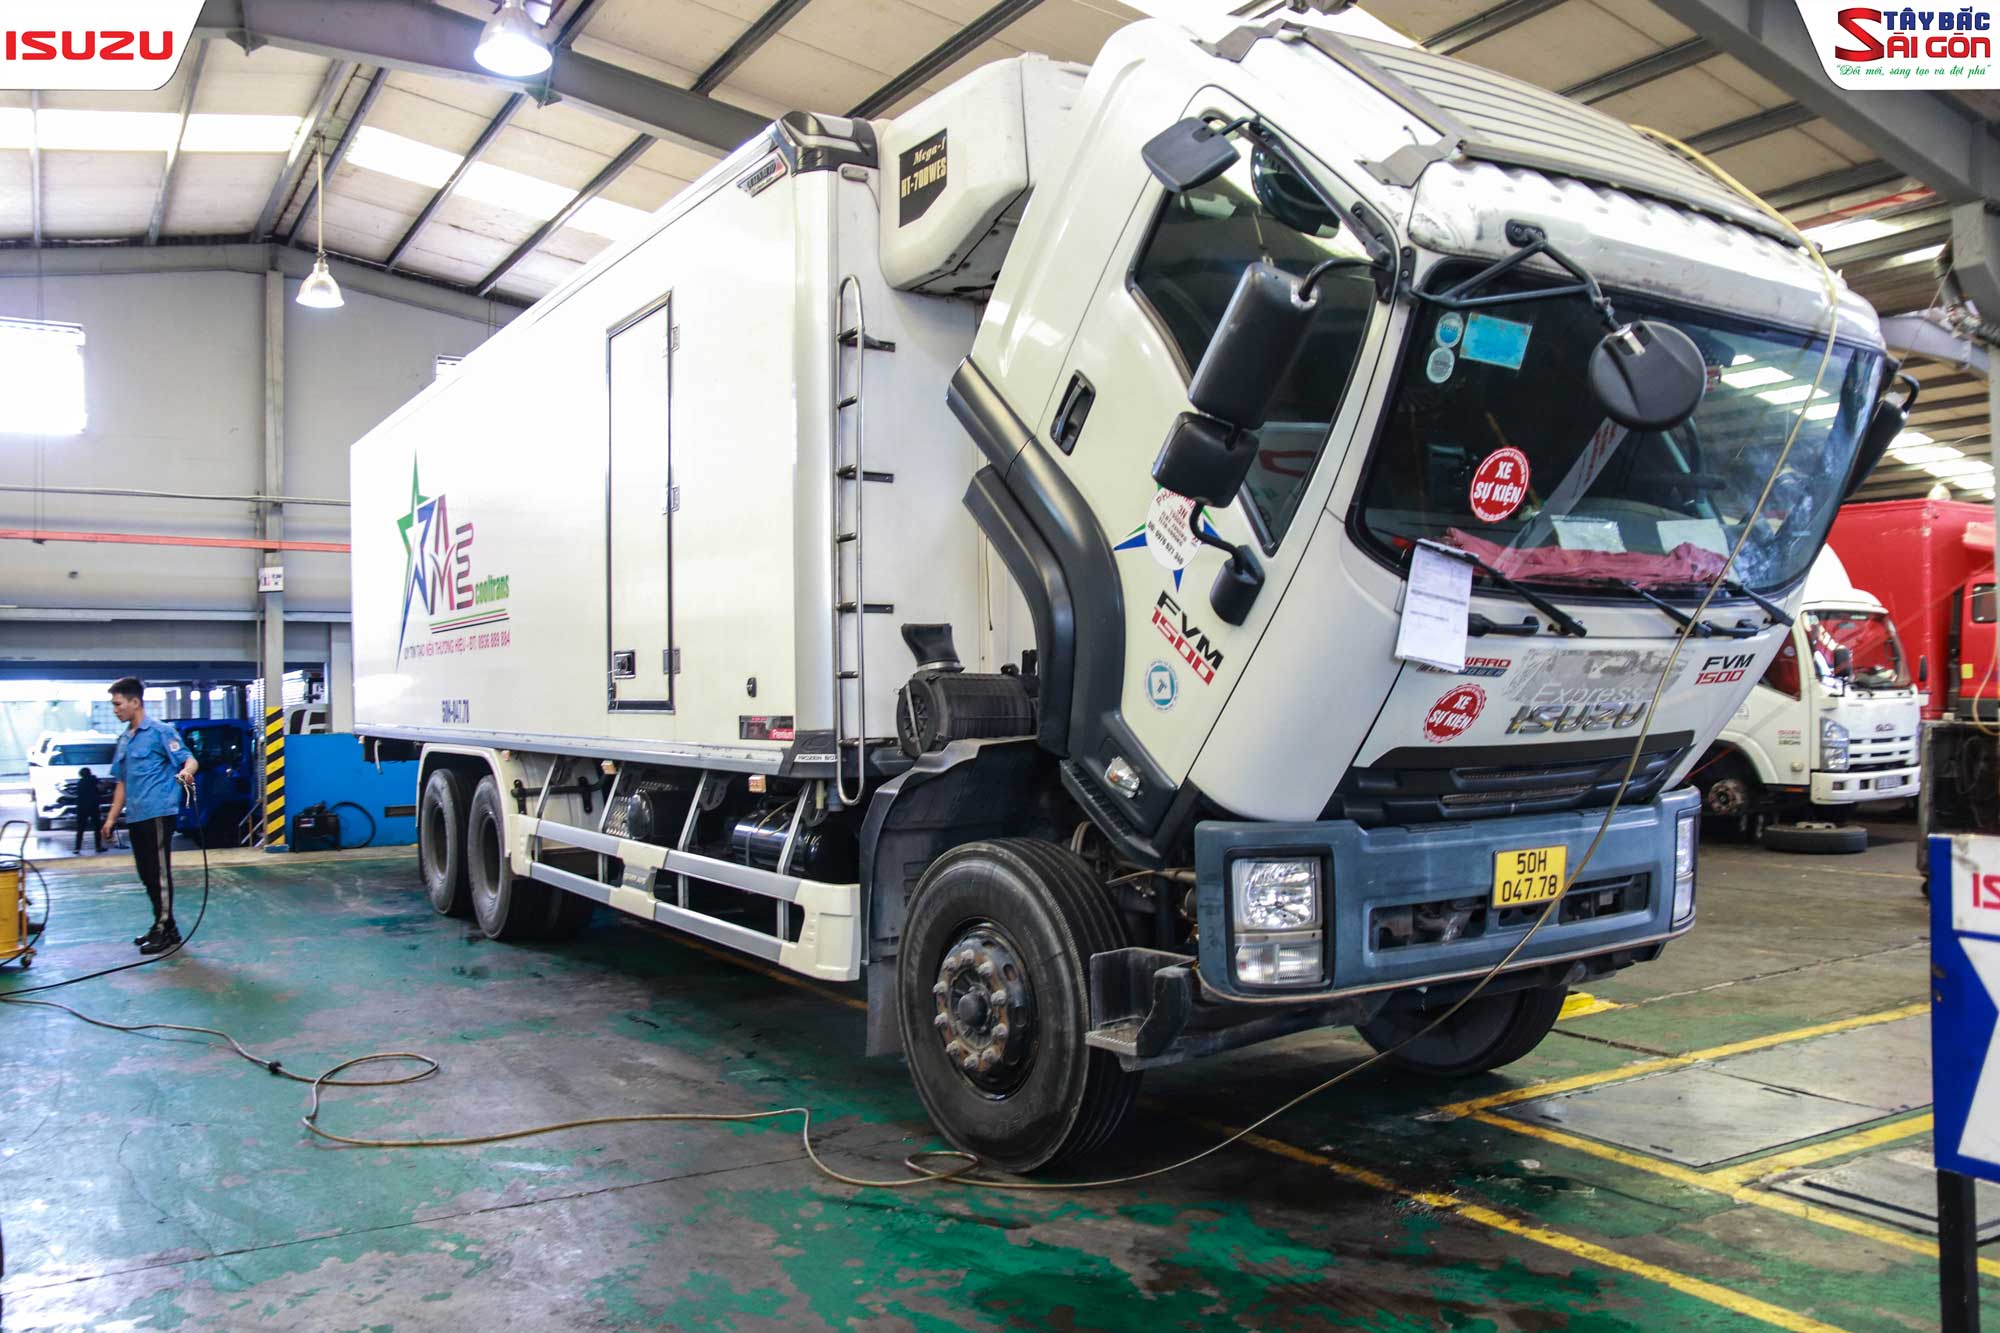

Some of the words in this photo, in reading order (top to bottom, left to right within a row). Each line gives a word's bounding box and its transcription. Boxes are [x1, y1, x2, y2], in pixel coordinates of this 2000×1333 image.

[1495, 460, 1514, 479] XE
[1473, 481, 1495, 504] SỰ
[1491, 482, 1523, 507] KIỆN
[475, 574, 510, 605] cooltrans
[1157, 590, 1225, 671] FVM
[1151, 606, 1215, 687] 1500
[1464, 657, 1512, 668] WARD
[1702, 653, 1756, 671] FVM
[1695, 670, 1747, 685] 1500
[1452, 695, 1473, 710] XE
[1532, 681, 1644, 704] Express
[1429, 709, 1452, 728] SỰ
[1443, 712, 1473, 731] KIỆN
[1504, 702, 1648, 735] ISUZU
[1516, 850, 1548, 875] 50H
[1502, 874, 1558, 903] 047.78
